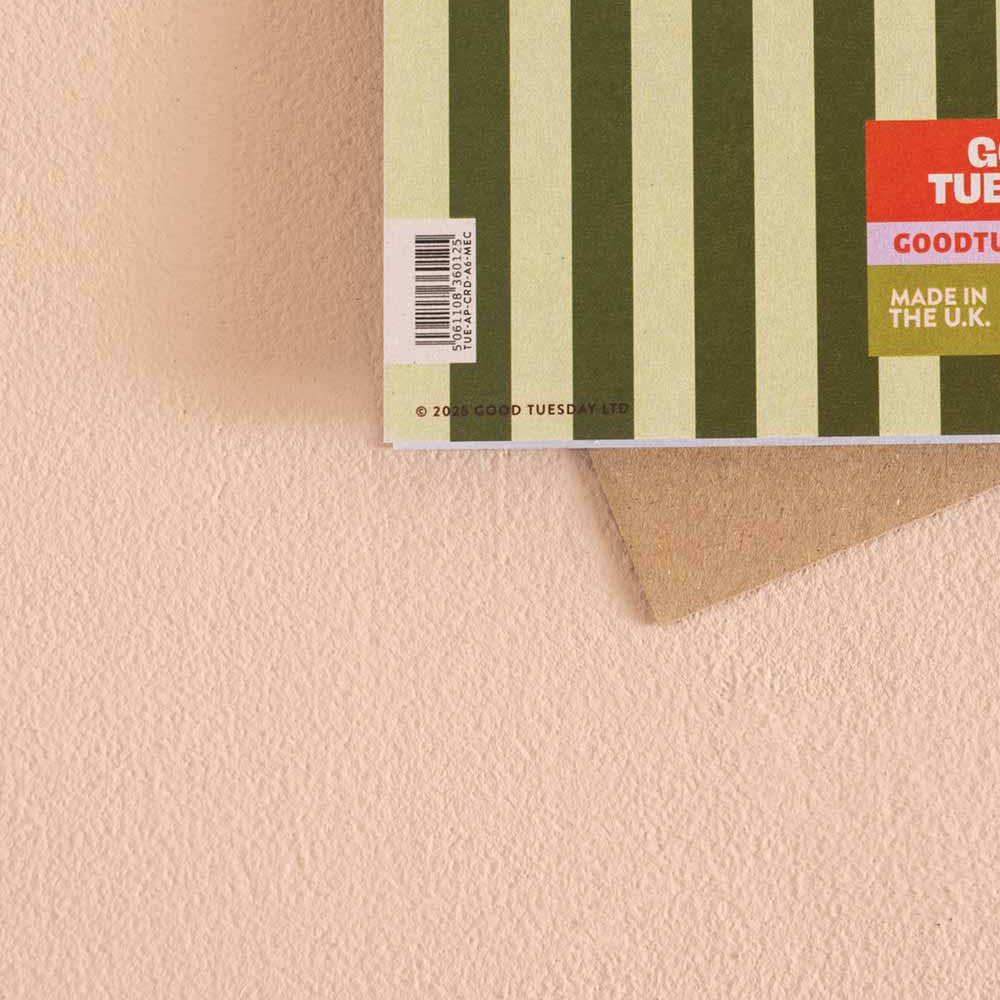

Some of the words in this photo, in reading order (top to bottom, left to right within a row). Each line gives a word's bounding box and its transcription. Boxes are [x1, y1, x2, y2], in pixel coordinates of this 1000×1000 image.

[463, 231, 472, 350] TUE-AP-CRD-A6-MEC
[890, 287, 957, 306] MADE
[963, 287, 987, 305] IN
[889, 307, 937, 328] THE
[944, 307, 991, 328] U.K.
[433, 406, 468, 417] 2025
[474, 404, 521, 416] GOOD
[528, 403, 596, 416] TUESDAY
[602, 402, 629, 415] LTD
